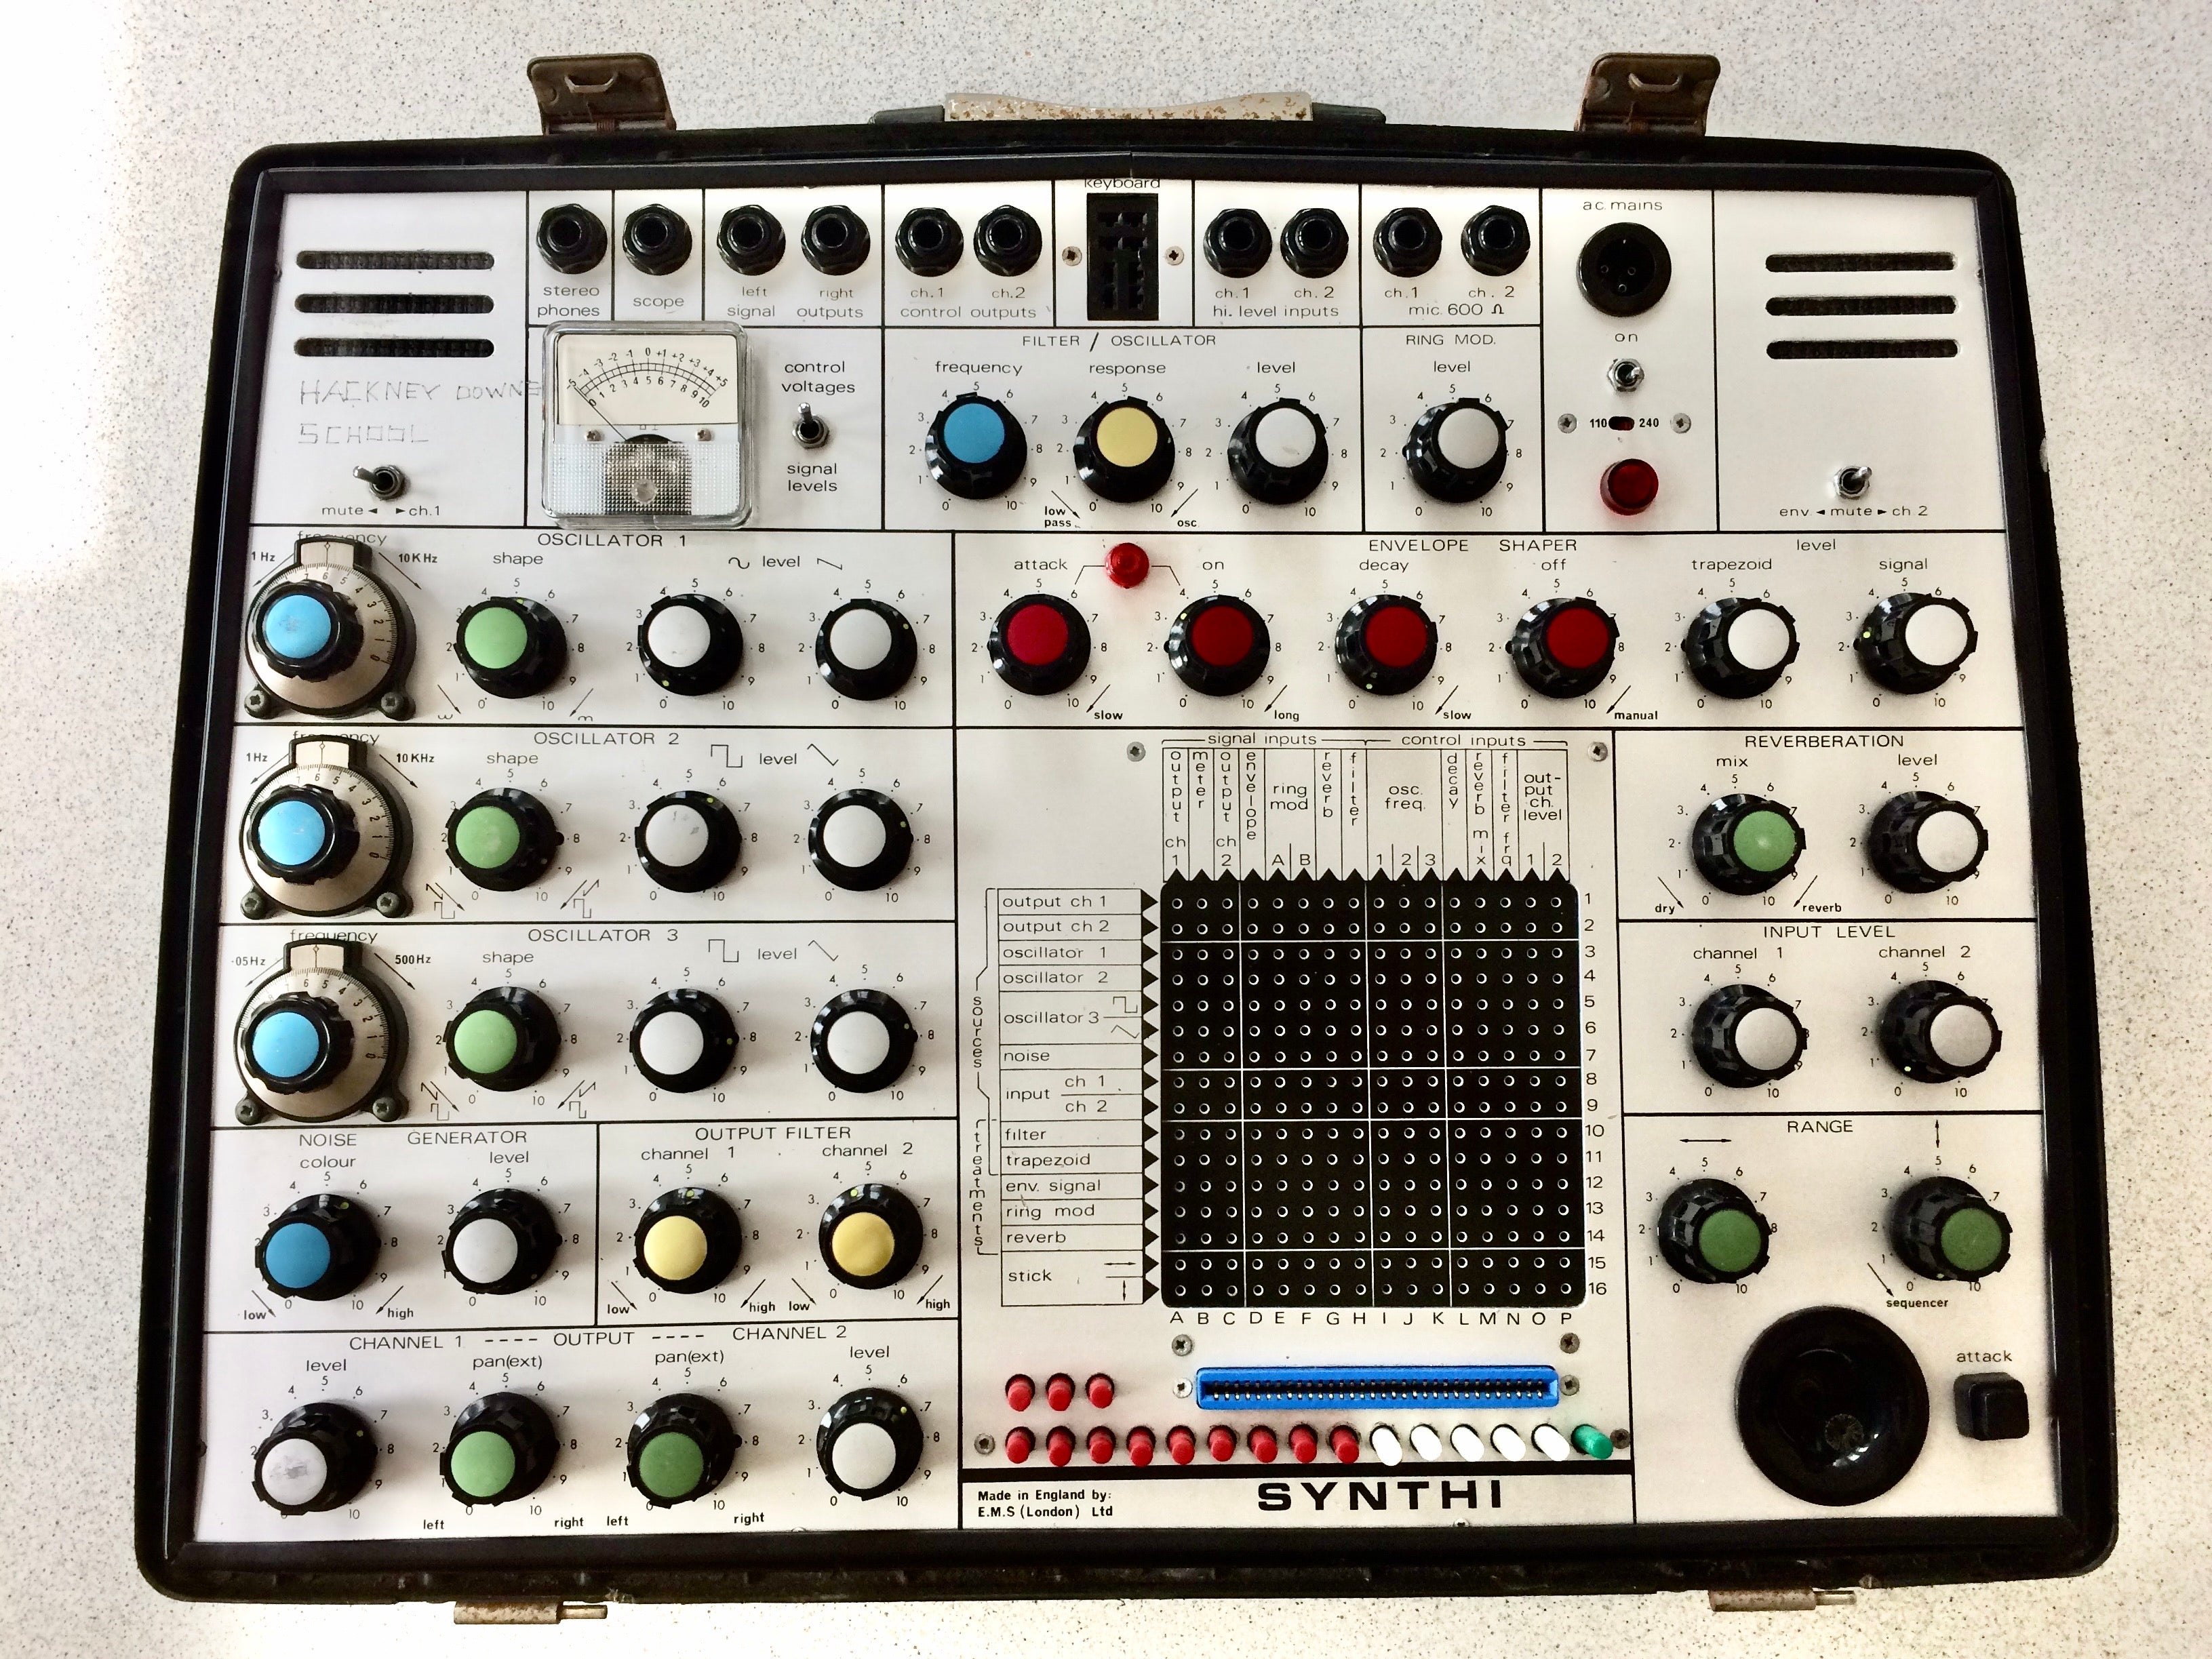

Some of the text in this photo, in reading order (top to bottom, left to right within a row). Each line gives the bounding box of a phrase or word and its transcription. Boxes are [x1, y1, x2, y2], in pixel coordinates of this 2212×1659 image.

[1084, 178, 1160, 188] keyboard
[1611, 201, 1663, 211] mains
[543, 285, 600, 296] stereo
[742, 286, 766, 297] left
[820, 287, 853, 300] right
[633, 297, 684, 310] scope
[1448, 303, 1483, 316] 600
[537, 304, 600, 318] phones
[727, 305, 863, 321] signal outputs
[900, 306, 1036, 321] control outputs
[1239, 305, 1276, 317] level
[1284, 306, 1339, 319] inputs
[1023, 334, 1216, 346] FILTER OSCILLATOR
[1406, 334, 1444, 346] RING
[1615, 333, 1638, 342] on
[784, 361, 845, 374] control
[934, 361, 1023, 377] frequency
[1089, 364, 1166, 377] response
[1257, 361, 1295, 374] level
[1434, 360, 1470, 373] level
[300, 380, 440, 405] HACKNEY
[781, 380, 855, 396] voltages
[1589, 418, 1608, 428] 110
[1639, 418, 1659, 428] 240
[300, 423, 430, 443] SCHOOL
[787, 462, 837, 477] signal
[788, 479, 837, 492] levels
[321, 506, 363, 516] mute
[1044, 506, 1066, 516] low
[1305, 506, 1316, 517] 10
[1830, 505, 1928, 517] mute ch 2
[1044, 519, 1071, 528] pass
[538, 533, 686, 547] OSCILLATOR 1
[1369, 539, 1577, 552] ENVELOPE SHAPER
[1796, 538, 1836, 551] level
[493, 551, 544, 567] shape
[762, 555, 800, 567] level
[1014, 558, 1068, 570] attack
[1202, 561, 1224, 570] on
[1541, 558, 1566, 571] off
[1691, 558, 1772, 573] trapezoid
[1879, 557, 1928, 573] signal
[1359, 559, 1409, 574] decay
[1094, 710, 1124, 720] slow
[1274, 709, 1299, 722] long
[1443, 710, 1472, 720] slow
[1614, 710, 1658, 721] manual
[534, 732, 679, 745] OSCILLATOR 2
[1208, 732, 1317, 747] signal inputs
[1402, 734, 1526, 748] control inputs
[1745, 734, 1903, 748] REVERBERATION
[487, 752, 538, 767] shape
[759, 753, 797, 765] level
[1716, 757, 1748, 767] mix
[1898, 753, 1937, 766] level
[1273, 785, 1307, 798] ring
[1270, 797, 1308, 811] mod
[1002, 895, 1105, 910] output ch 1
[1655, 903, 1675, 915] dry
[1802, 902, 1842, 913] reverb
[528, 928, 678, 942] OSCILLATOR 3
[1764, 925, 1896, 938] INPUT LEVEL
[757, 947, 797, 960] level
[1003, 946, 1105, 959] oscillator 1
[1693, 946, 1782, 959] channel 1
[1878, 945, 1971, 958] channel 2
[483, 951, 534, 966] shape
[1004, 1011, 1099, 1024] oscillator 3
[1004, 1052, 1050, 1062] noise
[1065, 1075, 1104, 1087] ch 1
[1006, 1089, 1050, 1102] input
[1766, 1087, 1779, 1098] 10
[1788, 1119, 1853, 1133] RANGE
[299, 1130, 527, 1147] NOISE GENERATOR
[695, 1126, 851, 1141] OUTPUT FILTER
[1005, 1128, 1046, 1141] filter
[641, 1146, 734, 1161] channel 1
[822, 1142, 913, 1157] channel 2
[300, 1155, 356, 1169] colour
[490, 1151, 529, 1164] level
[1006, 1153, 1090, 1170] trapezoid
[1006, 1179, 1101, 1195] env. signal
[1006, 1203, 1094, 1221] ring mod
[1006, 1231, 1066, 1243] reverb
[1008, 1268, 1052, 1282] stick
[607, 1304, 630, 1315] low
[749, 1301, 776, 1314] high
[1885, 1299, 1949, 1310] sequencer
[243, 1310, 266, 1320] low
[387, 1307, 414, 1320] high
[349, 1325, 847, 1351] CHANNEL 1 OUTPUT CHANNEL 2
[655, 1350, 724, 1366] pan(ext)
[850, 1345, 890, 1359] level
[1956, 1350, 2013, 1363] attack
[307, 1358, 347, 1372] level
[473, 1355, 542, 1371] pan(ext)
[978, 1490, 1012, 1501] Made
[1018, 1490, 1029, 1500] in
[1035, 1489, 1085, 1502] England
[1258, 1479, 1501, 1511] SYNTHI
[1020, 1504, 1080, 1520] (London)
[1092, 1505, 1113, 1517] Ltd
[423, 1519, 445, 1530] left
[554, 1517, 585, 1530] right
[607, 1515, 629, 1526] left
[734, 1512, 765, 1526] right
